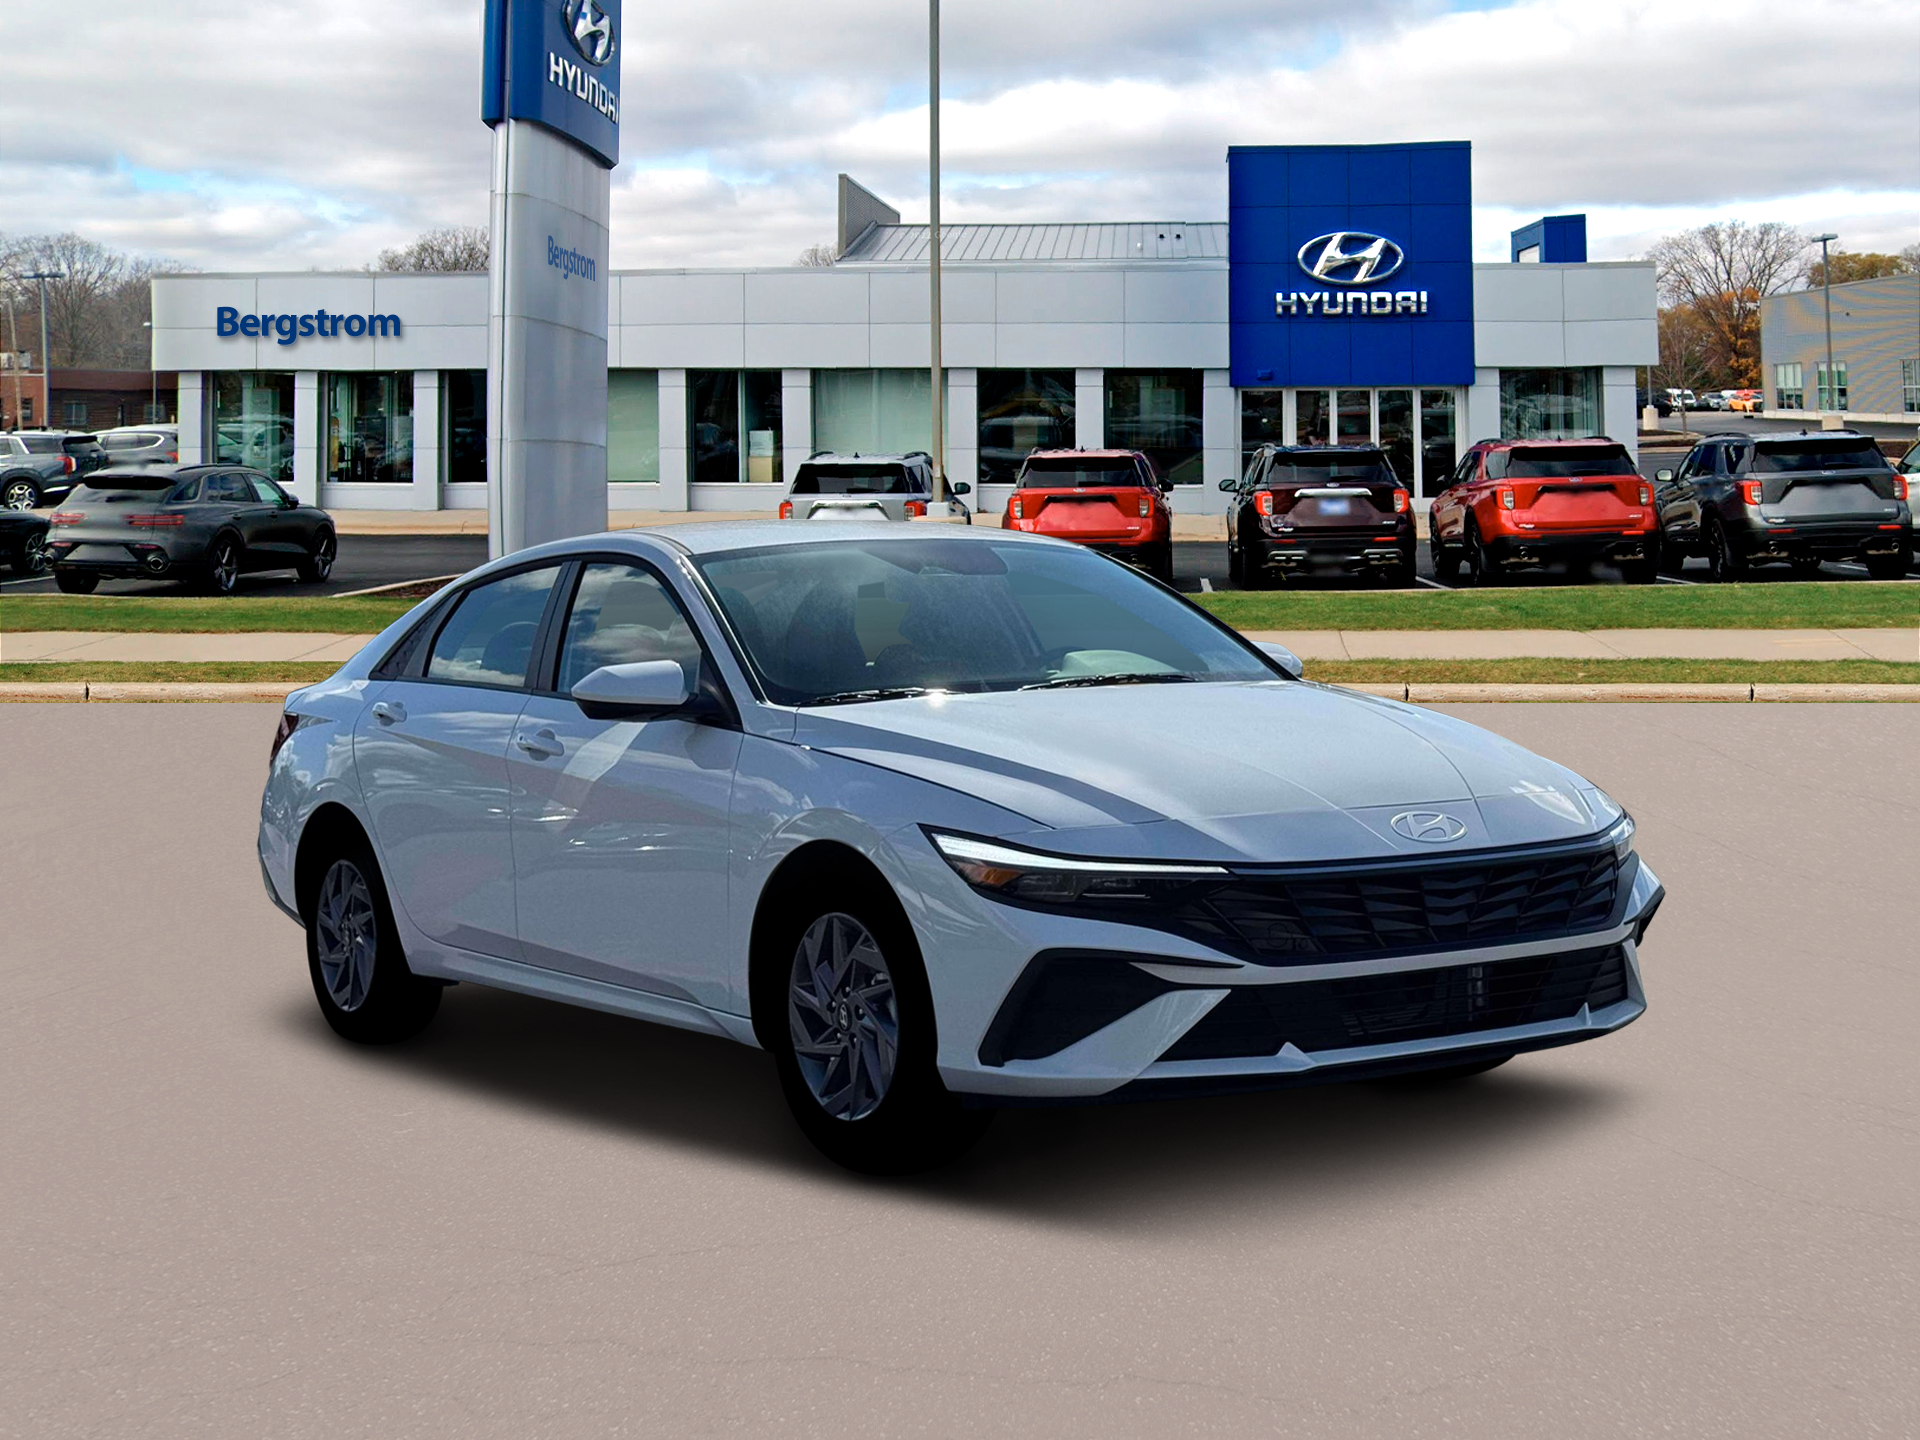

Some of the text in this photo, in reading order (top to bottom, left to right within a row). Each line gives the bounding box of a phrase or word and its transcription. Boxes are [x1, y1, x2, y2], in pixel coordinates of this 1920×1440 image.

[549, 52, 618, 124] HYUNDAI
[547, 235, 596, 281] Bergstrom
[1275, 290, 1427, 315] HYUNDAI
[216, 306, 401, 346] Bergstrom
